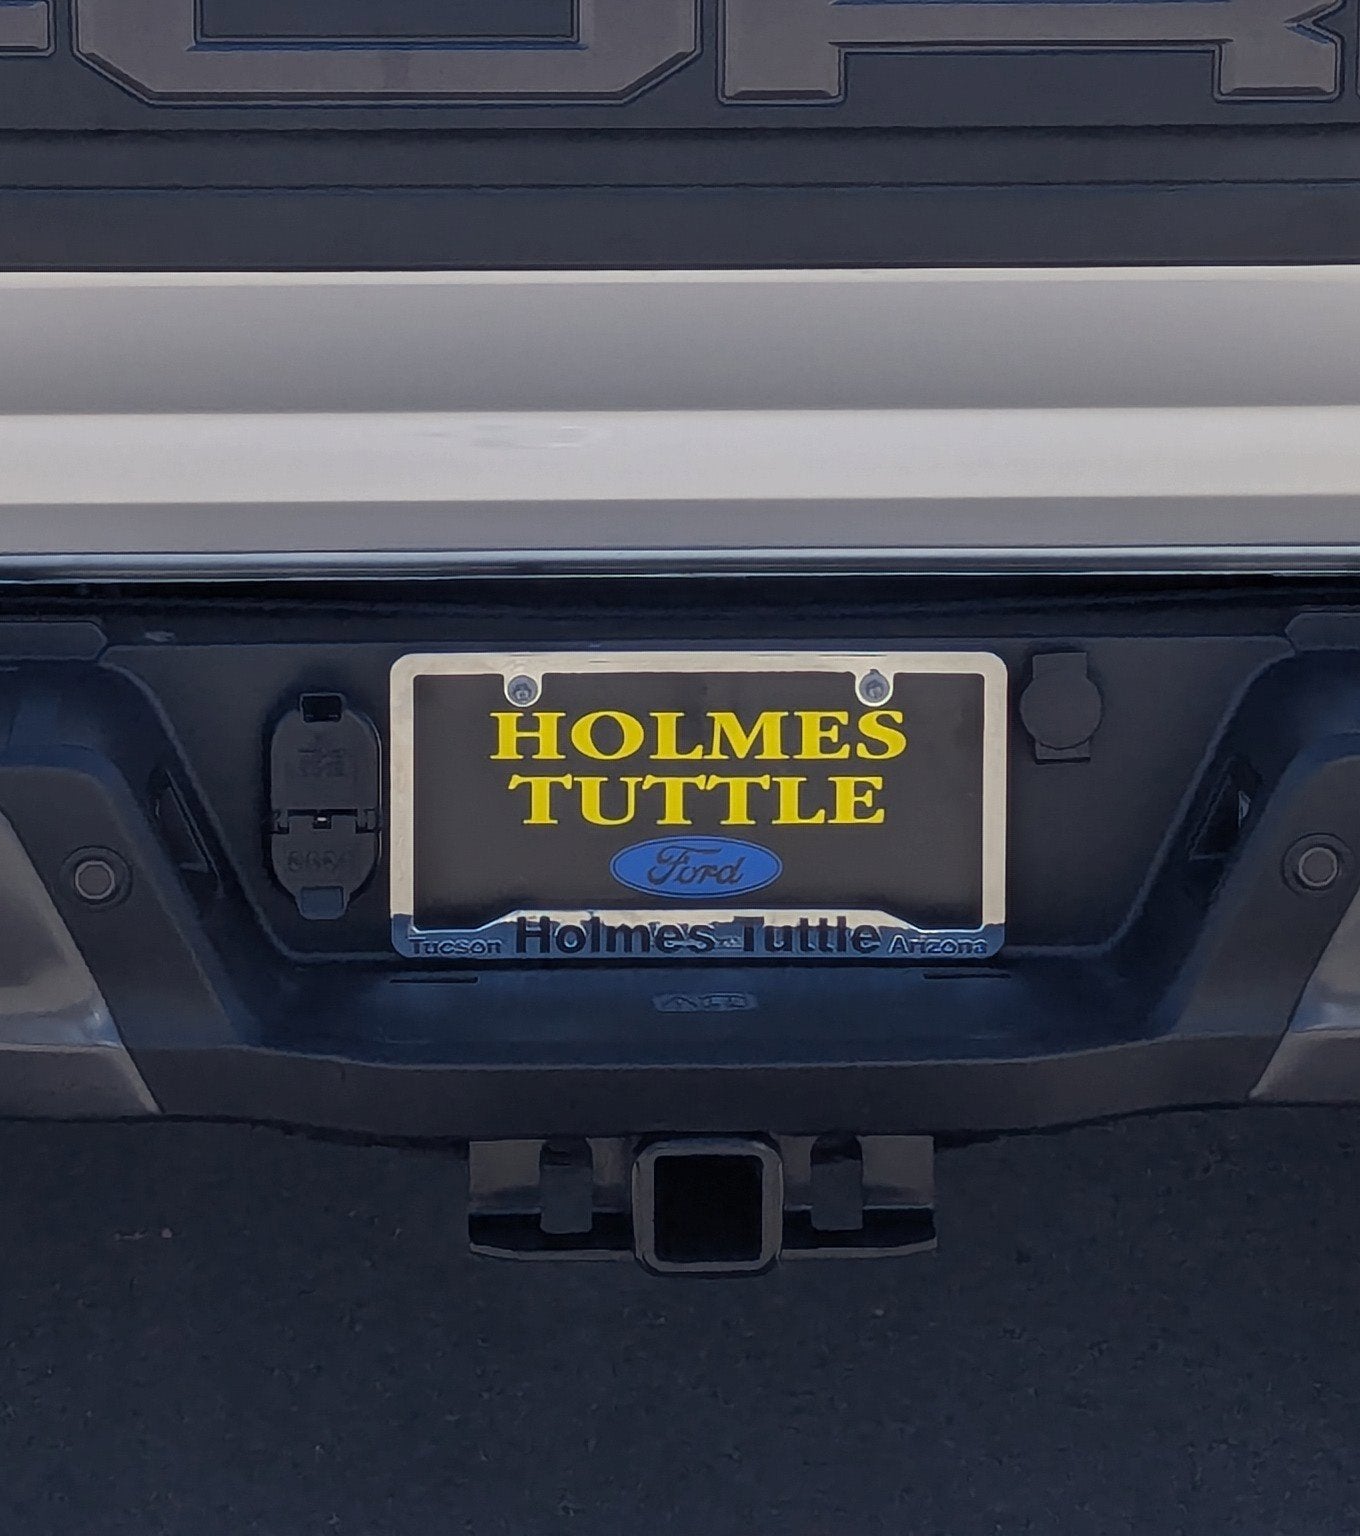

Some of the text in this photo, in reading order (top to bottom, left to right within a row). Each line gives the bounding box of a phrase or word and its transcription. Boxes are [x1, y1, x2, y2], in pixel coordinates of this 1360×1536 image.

[489, 709, 908, 761] HOLMES
[507, 773, 886, 826] TUTTLE
[646, 844, 748, 887] Ford
[410, 915, 989, 956] Tucson Holmes Tuttle Arizona
